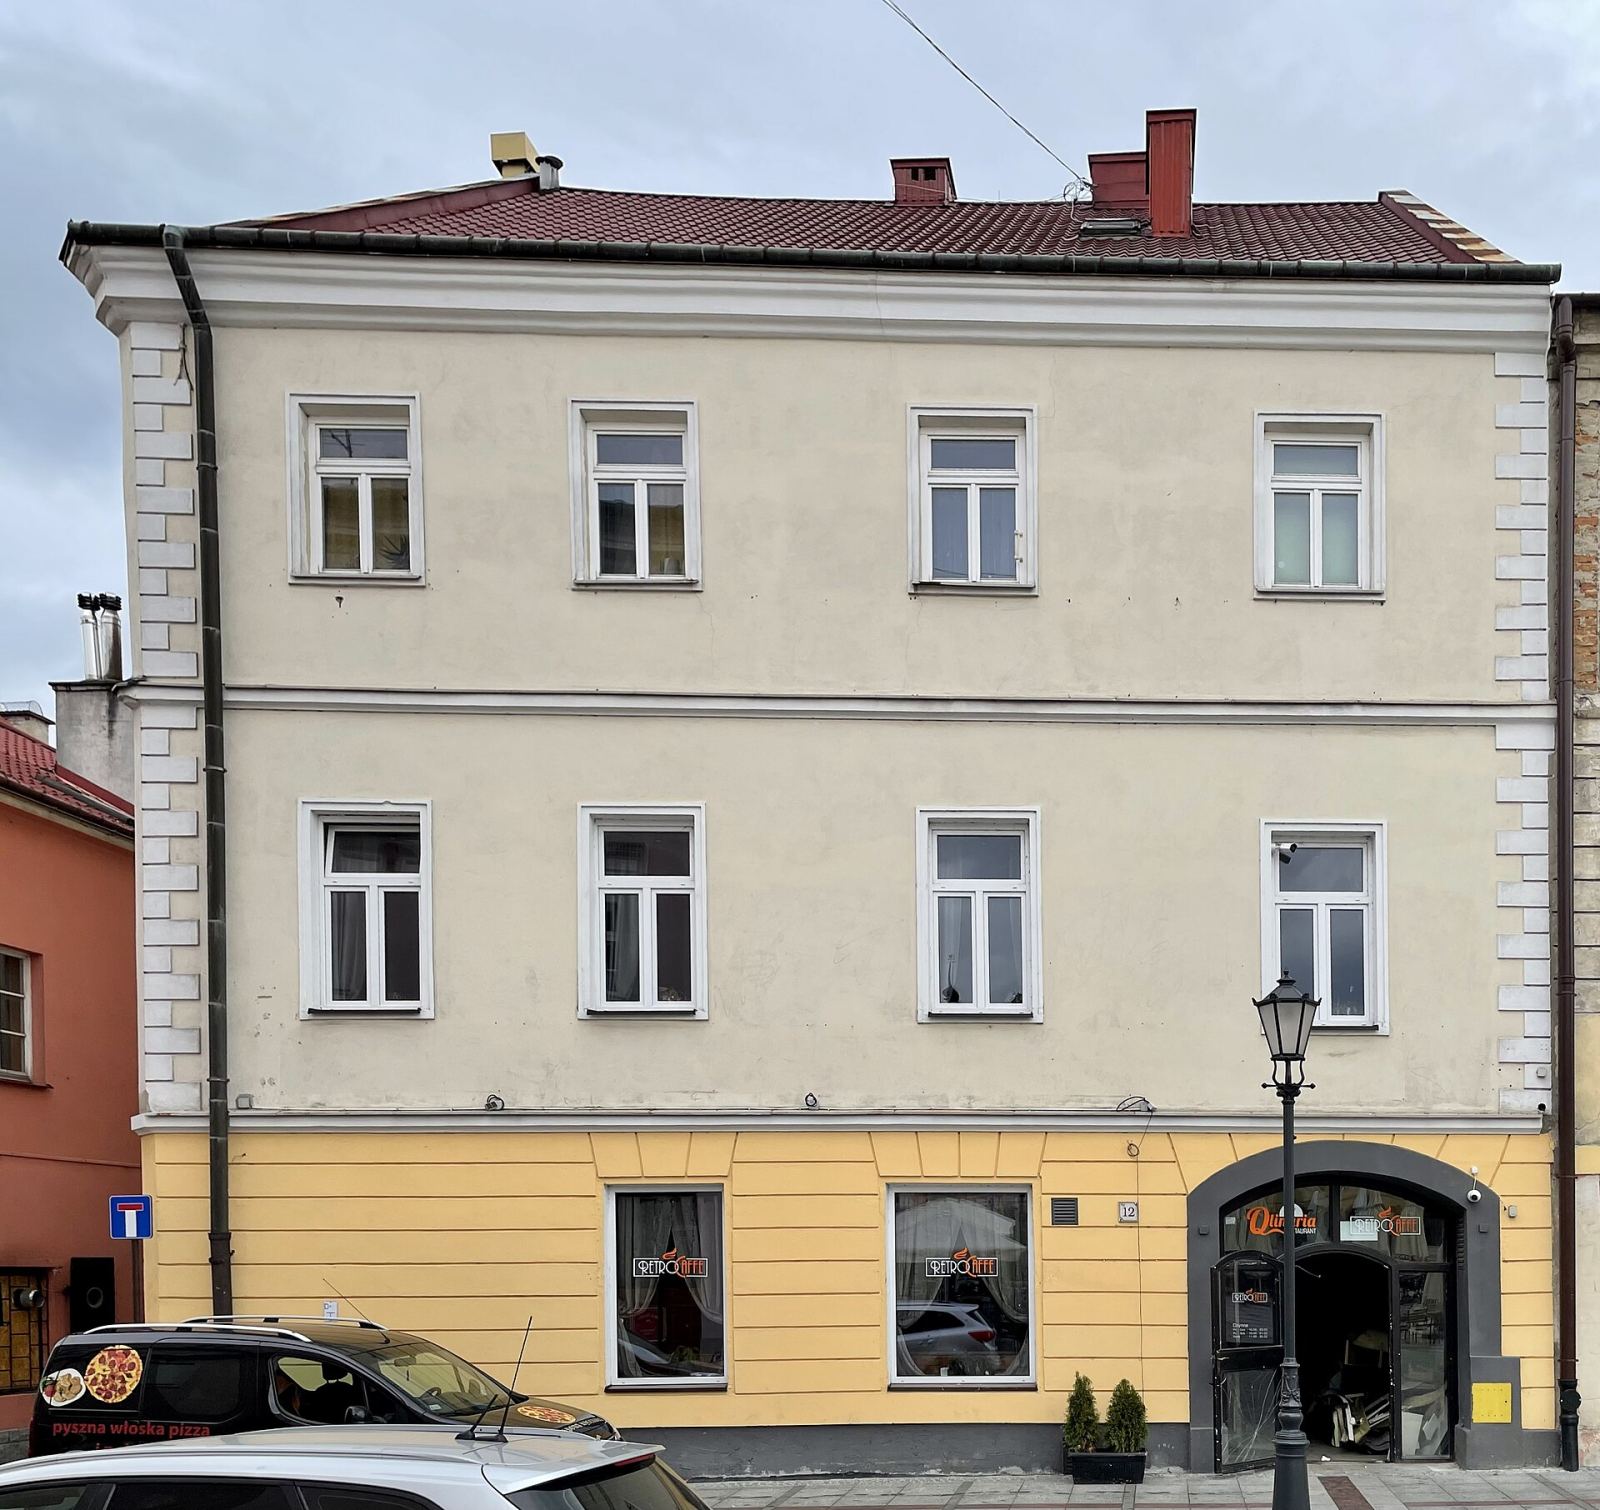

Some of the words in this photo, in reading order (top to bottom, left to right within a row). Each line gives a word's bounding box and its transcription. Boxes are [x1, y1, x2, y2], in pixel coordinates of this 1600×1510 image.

[1123, 1206, 1135, 1217] 12
[1246, 1206, 1317, 1236] Qlinria
[52, 1422, 106, 1436] pyszna
[110, 1420, 166, 1435] włoska
[169, 1423, 211, 1438] pizza
